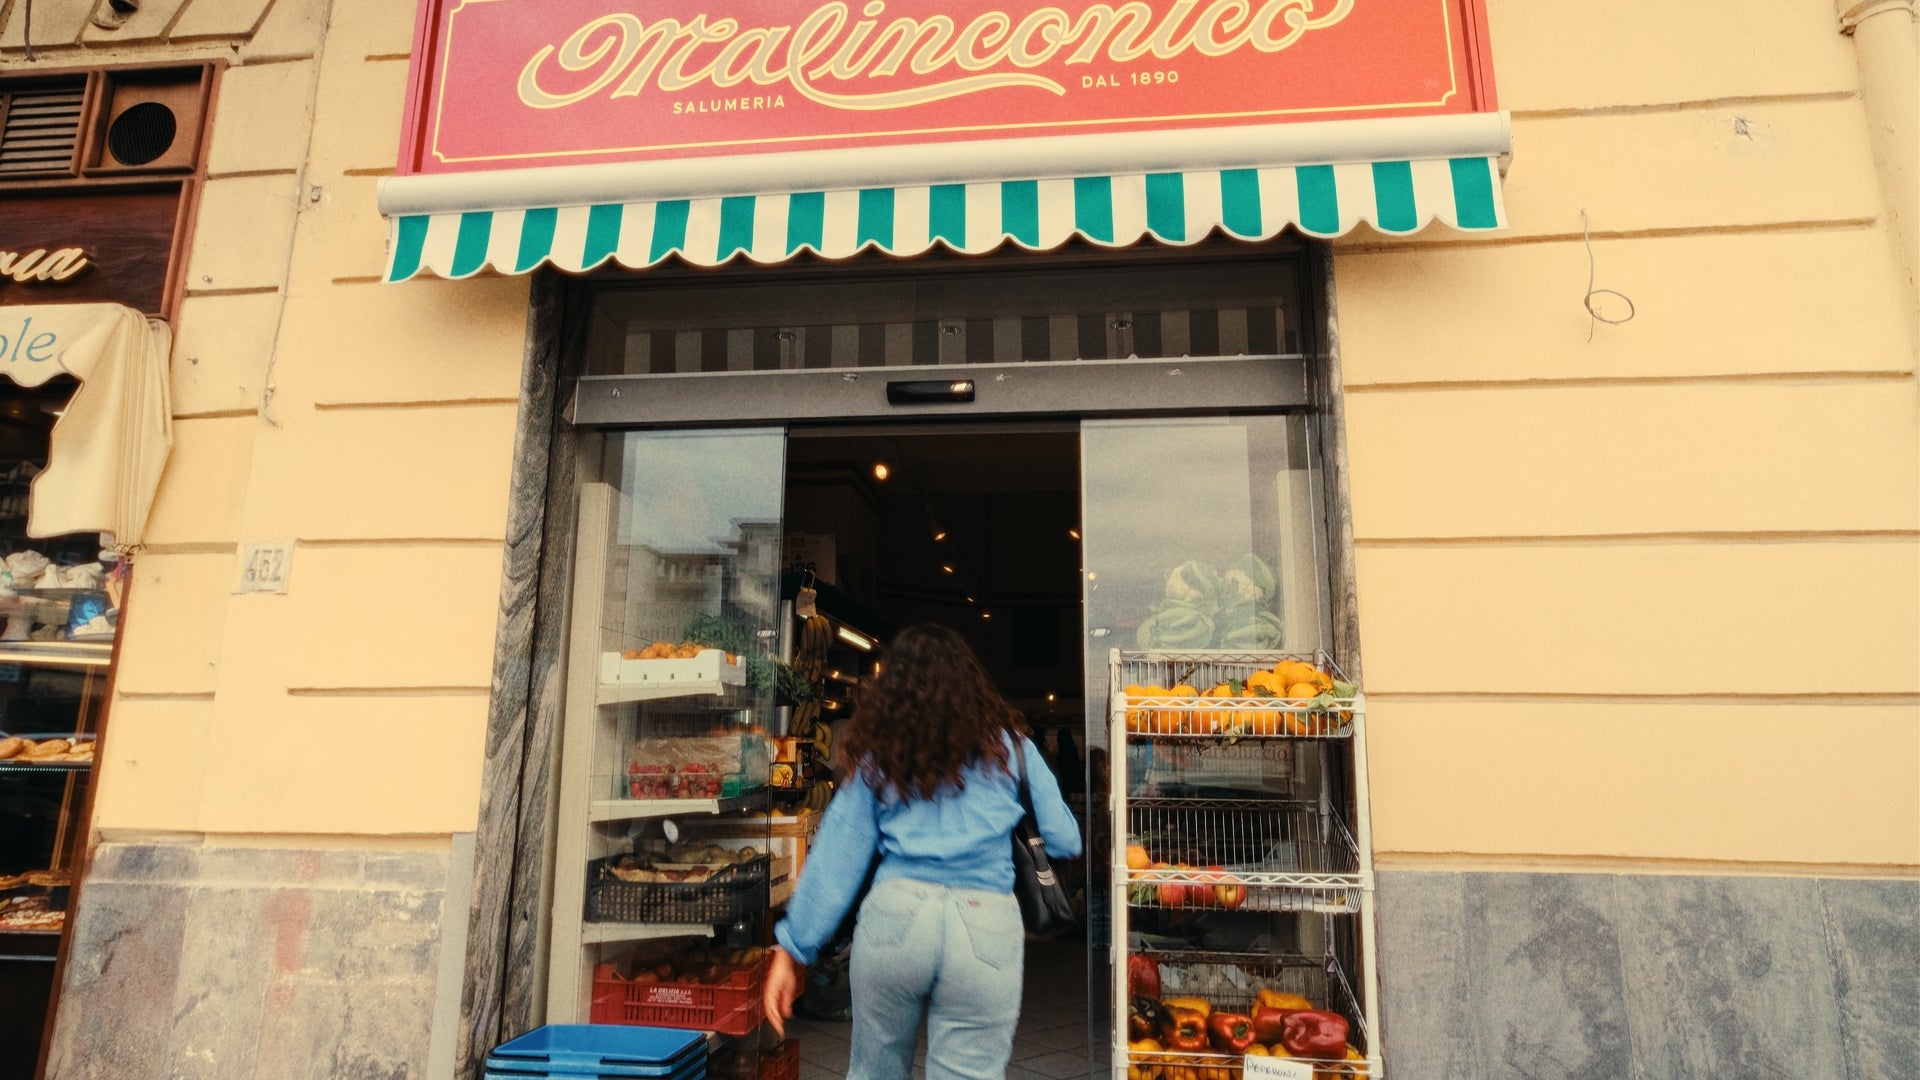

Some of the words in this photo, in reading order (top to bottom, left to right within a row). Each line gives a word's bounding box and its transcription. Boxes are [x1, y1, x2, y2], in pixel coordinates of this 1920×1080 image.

[1081, 74, 1121, 89] DAL
[1130, 70, 1179, 86] 1890
[672, 94, 785, 115] SALUMERIA
